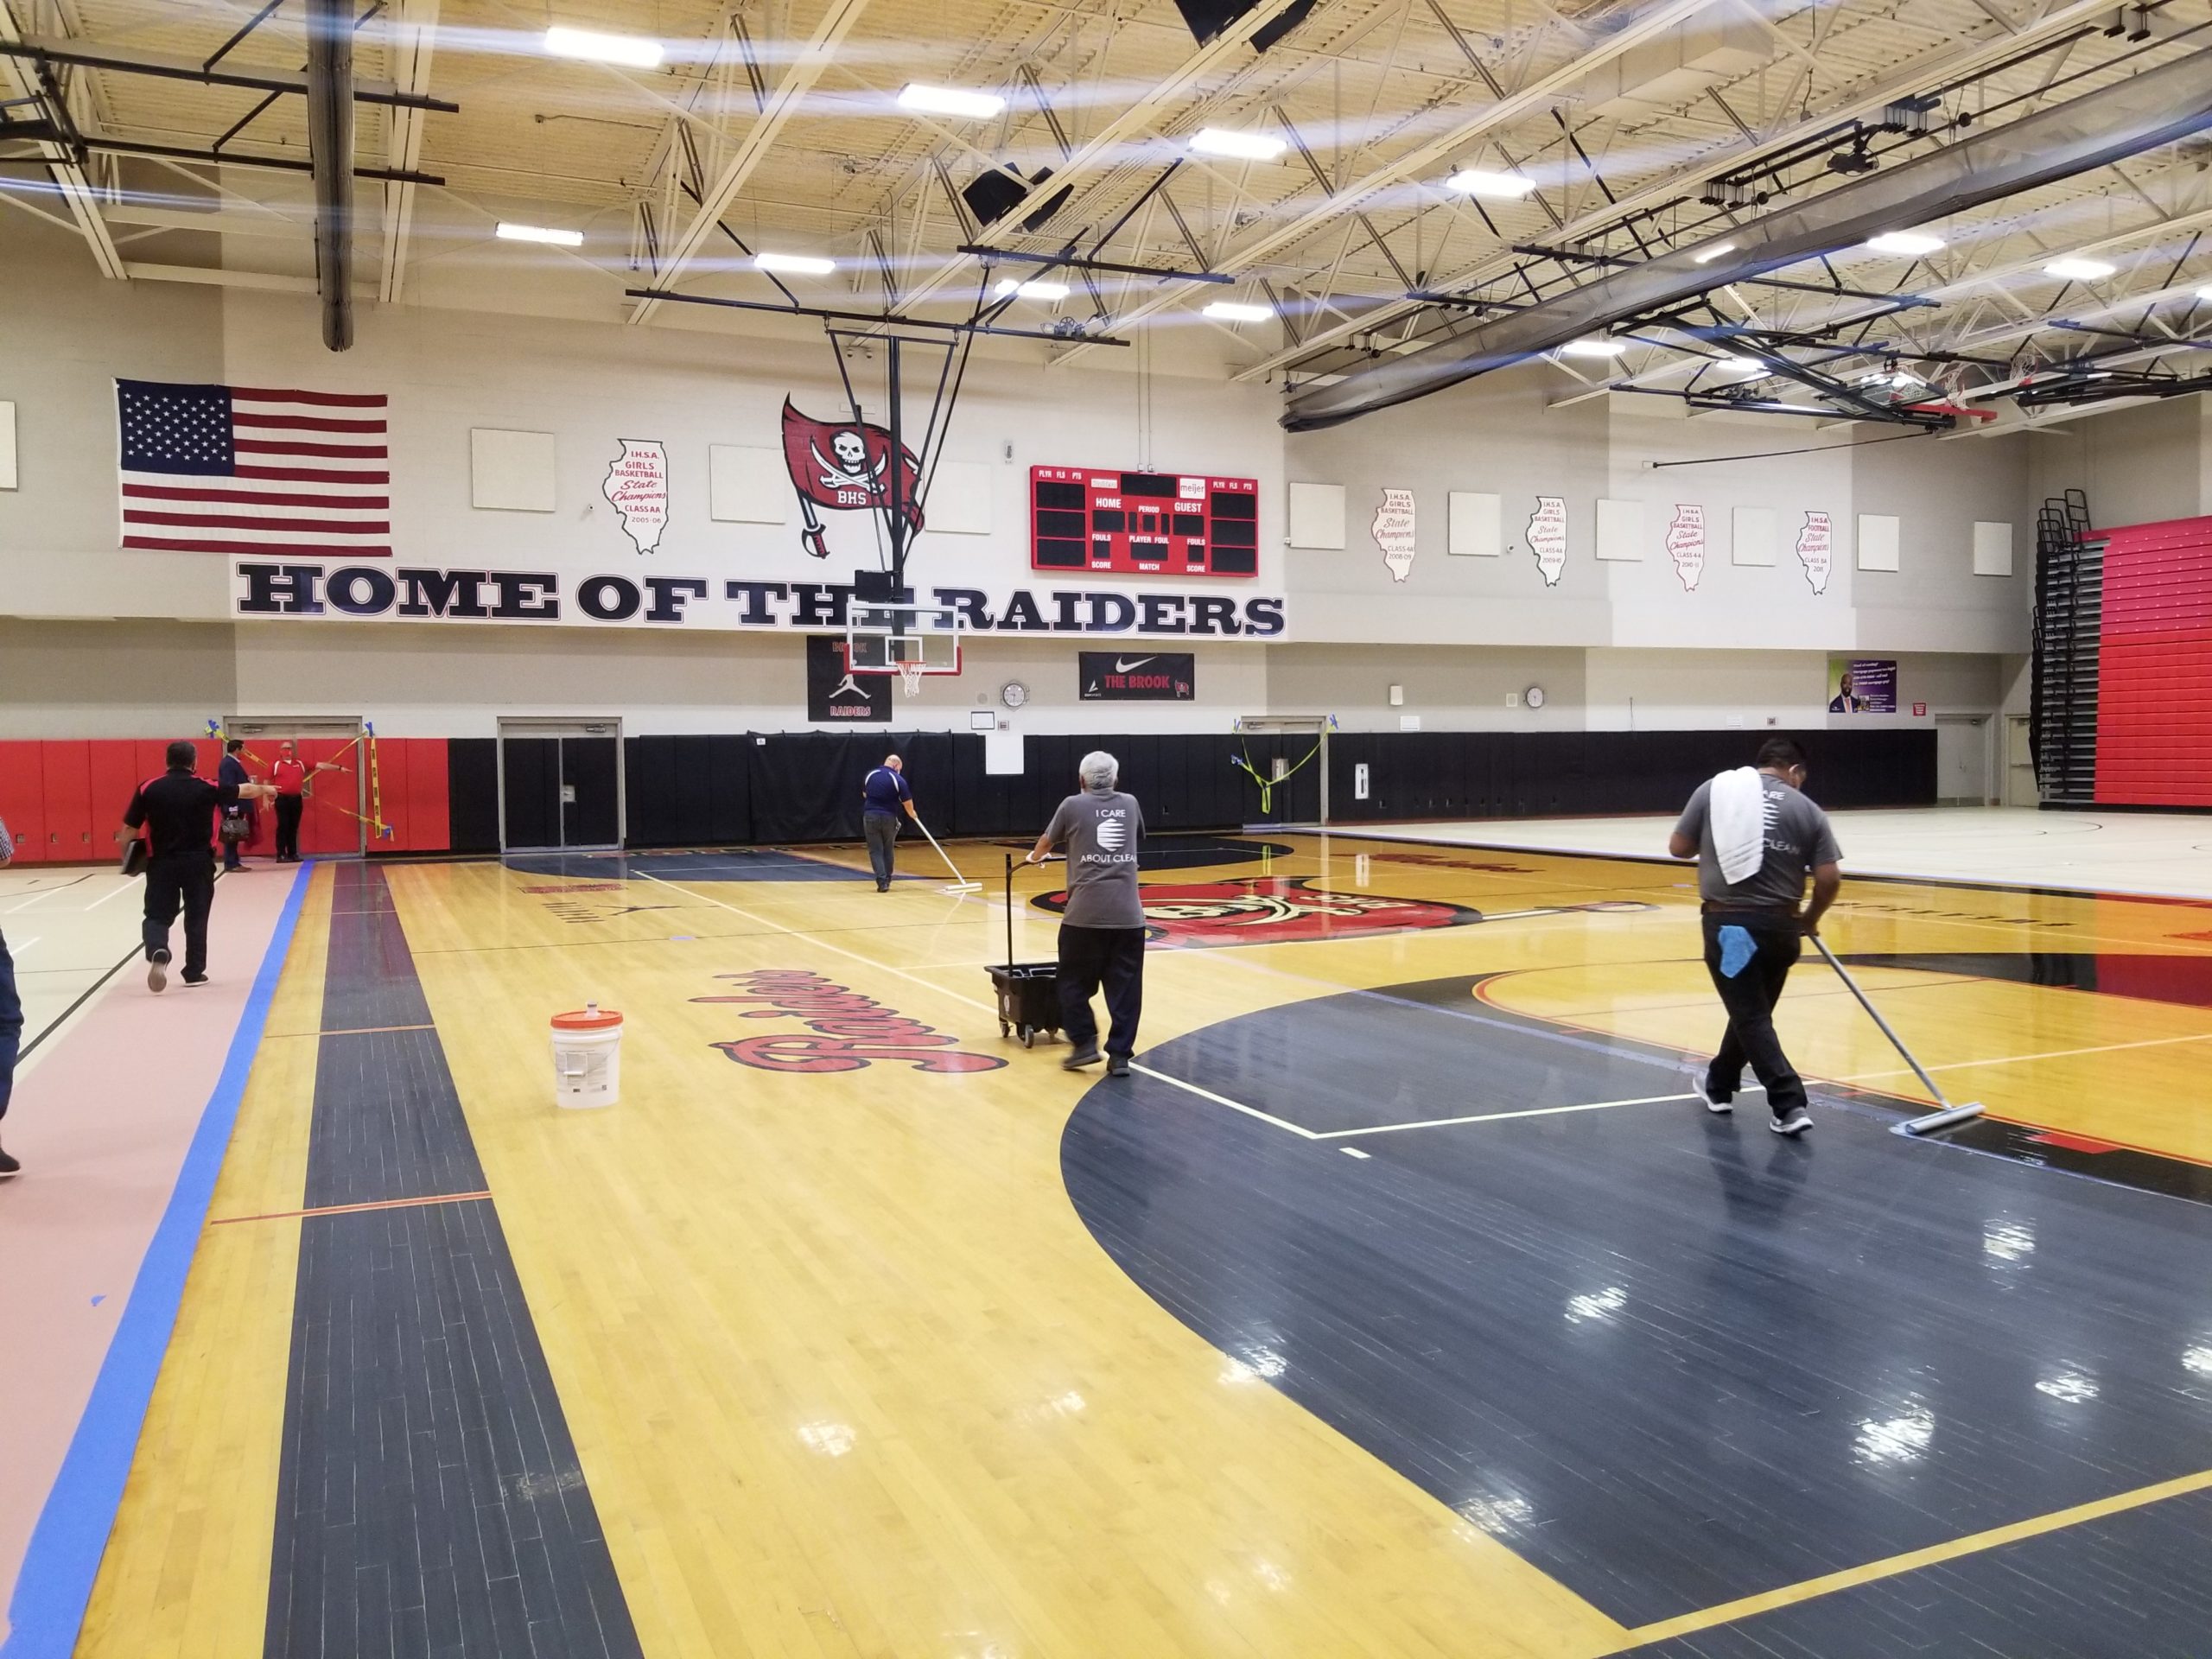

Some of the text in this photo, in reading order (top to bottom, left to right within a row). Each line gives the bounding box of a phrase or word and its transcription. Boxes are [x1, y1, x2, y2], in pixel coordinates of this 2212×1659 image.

[626, 461, 654, 470] GIRLS
[615, 469, 664, 479] BASKETBALL
[620, 480, 658, 490] State
[1180, 483, 1205, 494] meijer
[611, 490, 666, 502] Champions
[837, 490, 867, 505] BHS
[1096, 498, 1122, 508] HOME
[1174, 502, 1202, 512] GUEST
[625, 505, 649, 513] CLASS
[1383, 518, 1410, 528] State
[1538, 524, 1558, 534] State
[1376, 529, 1414, 540] Champions
[1676, 530, 1698, 539] State
[236, 562, 561, 622] HOME
[575, 573, 709, 625] OF
[931, 587, 1287, 638] RAIDERS
[1104, 675, 1170, 689] THE BROOK
[830, 706, 871, 716] RAIDERS
[1080, 854, 1136, 863] ABOUT CLEA
[688, 969, 1009, 1072] Raiders
